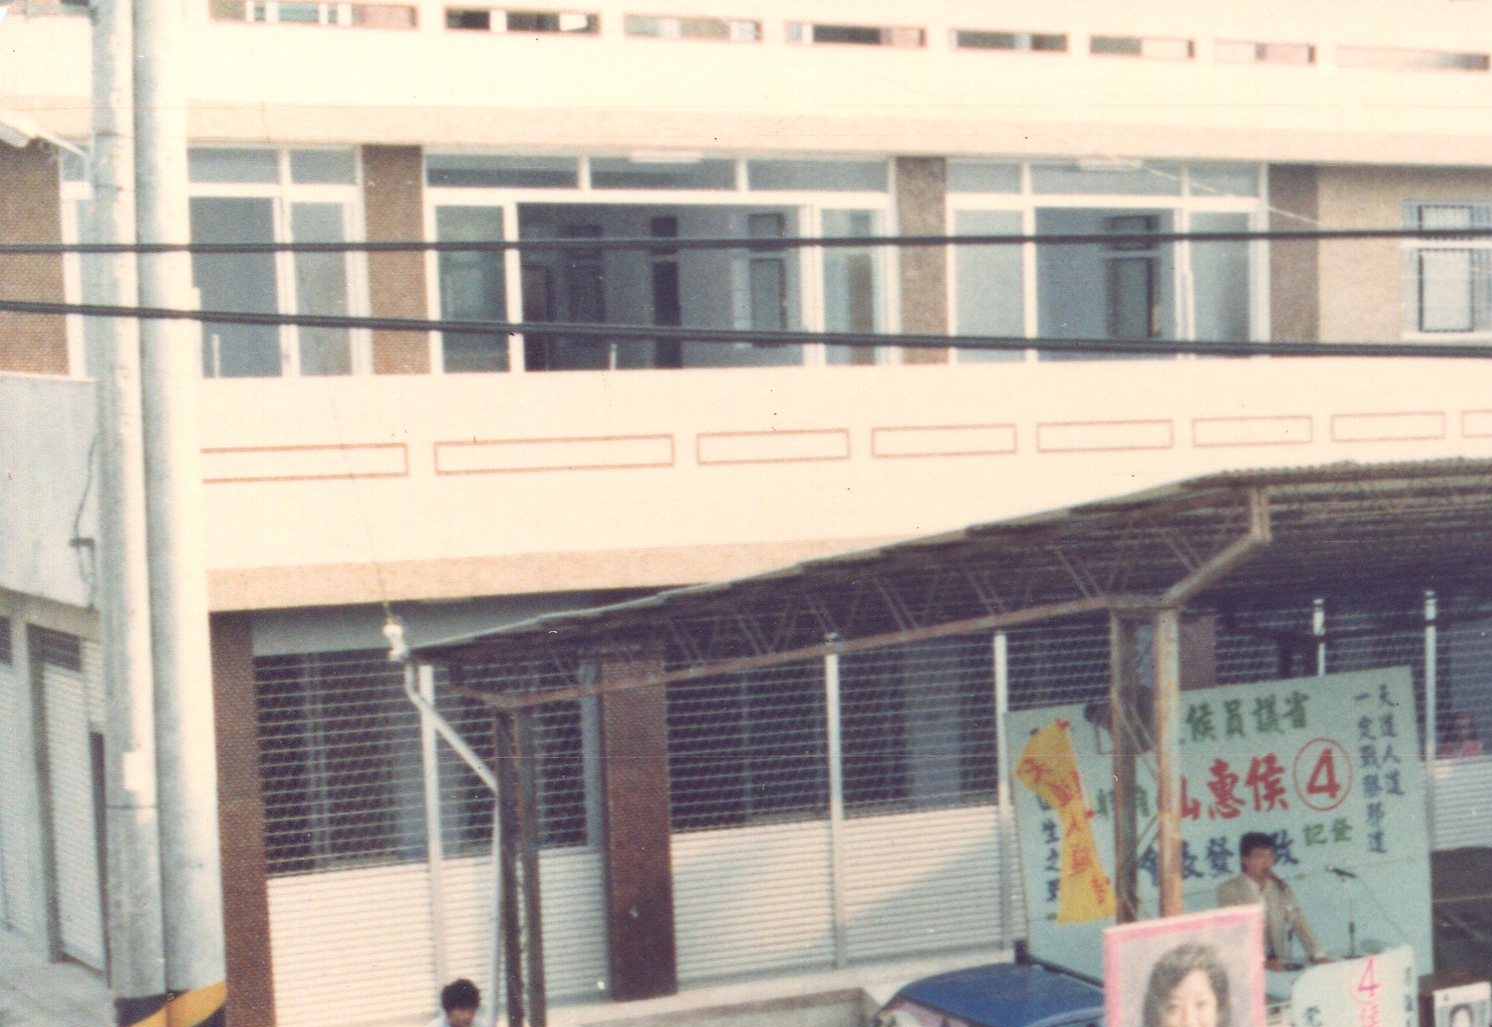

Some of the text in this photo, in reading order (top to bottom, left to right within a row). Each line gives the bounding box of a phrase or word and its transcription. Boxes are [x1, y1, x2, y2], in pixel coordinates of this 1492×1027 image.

[1180, 691, 1309, 745] 省議員候
[1377, 684, 1405, 796] 天道人道
[1302, 818, 1353, 847] 登記
